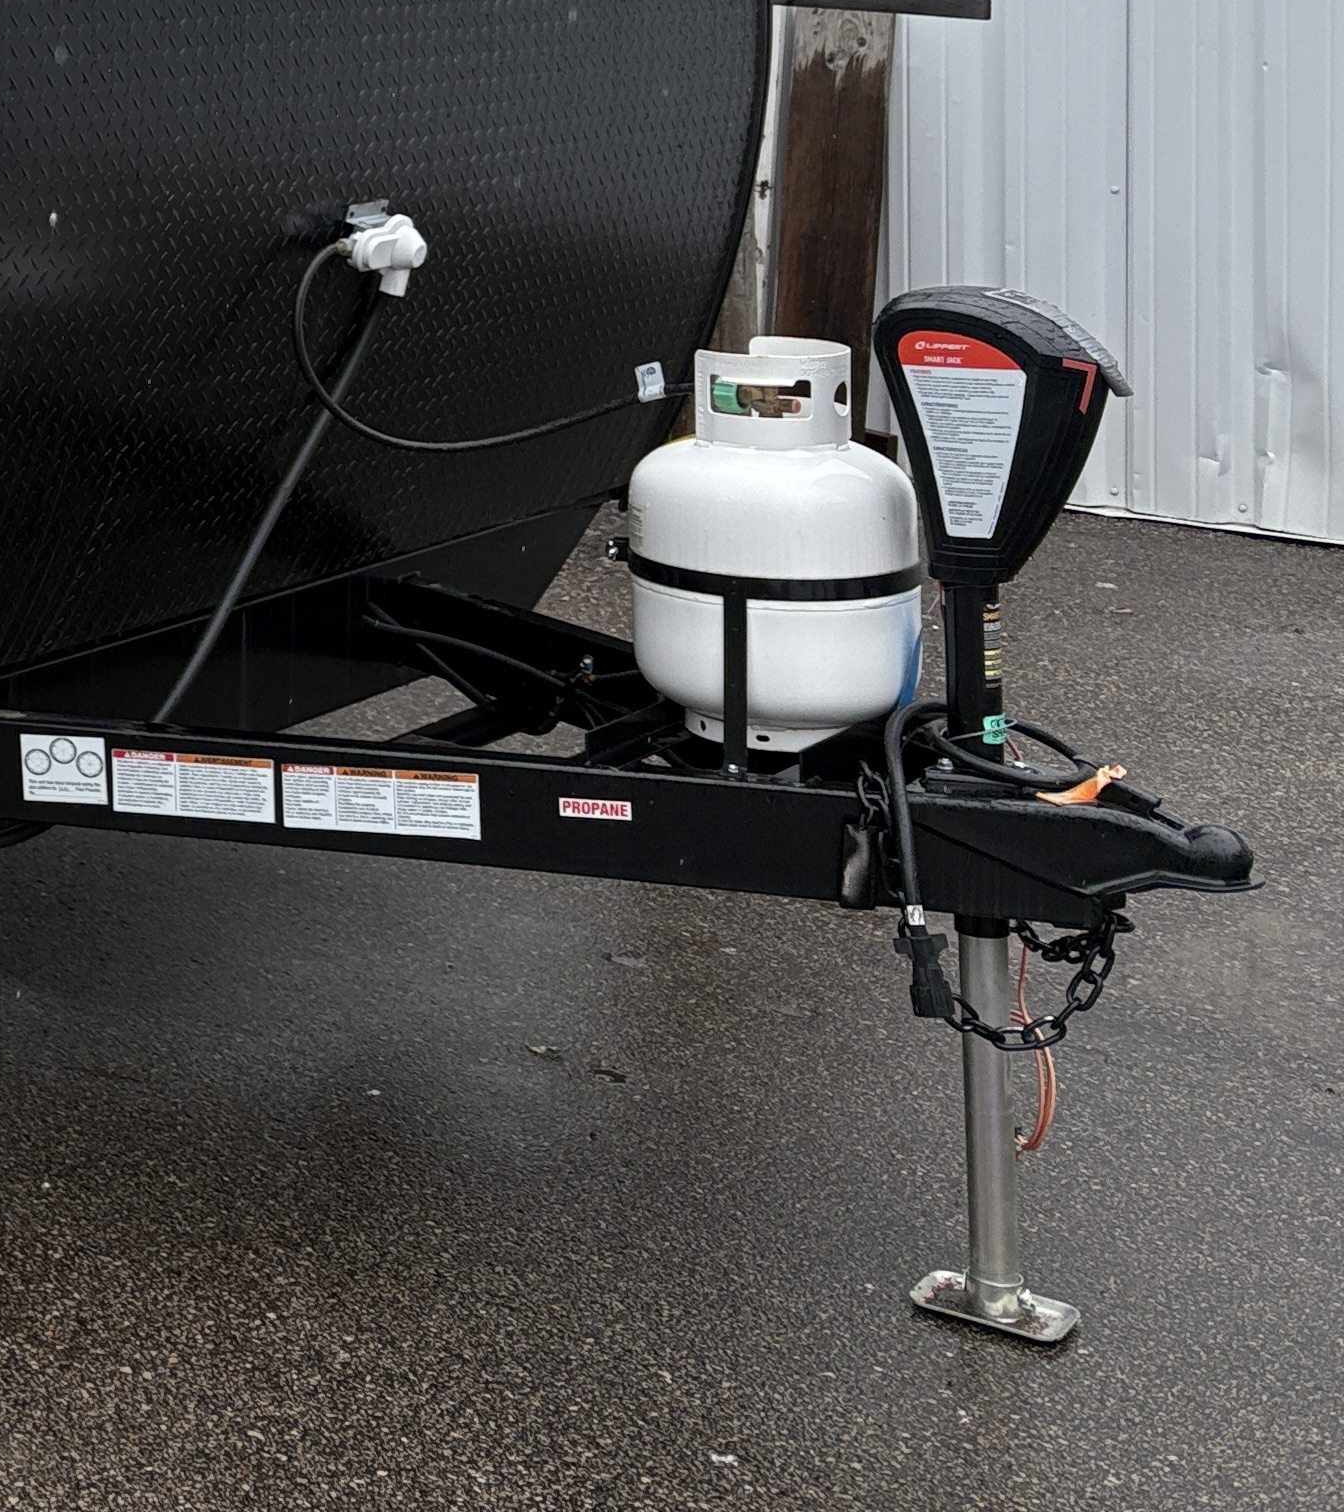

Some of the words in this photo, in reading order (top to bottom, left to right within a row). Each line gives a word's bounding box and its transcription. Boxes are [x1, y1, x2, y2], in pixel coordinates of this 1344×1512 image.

[925, 342, 971, 351] LIPPERT
[130, 751, 166, 761] DANGER
[294, 764, 330, 774] DANGER
[348, 769, 387, 778] WARNING
[420, 773, 459, 782] WARNING
[562, 800, 629, 818] PROPANE
